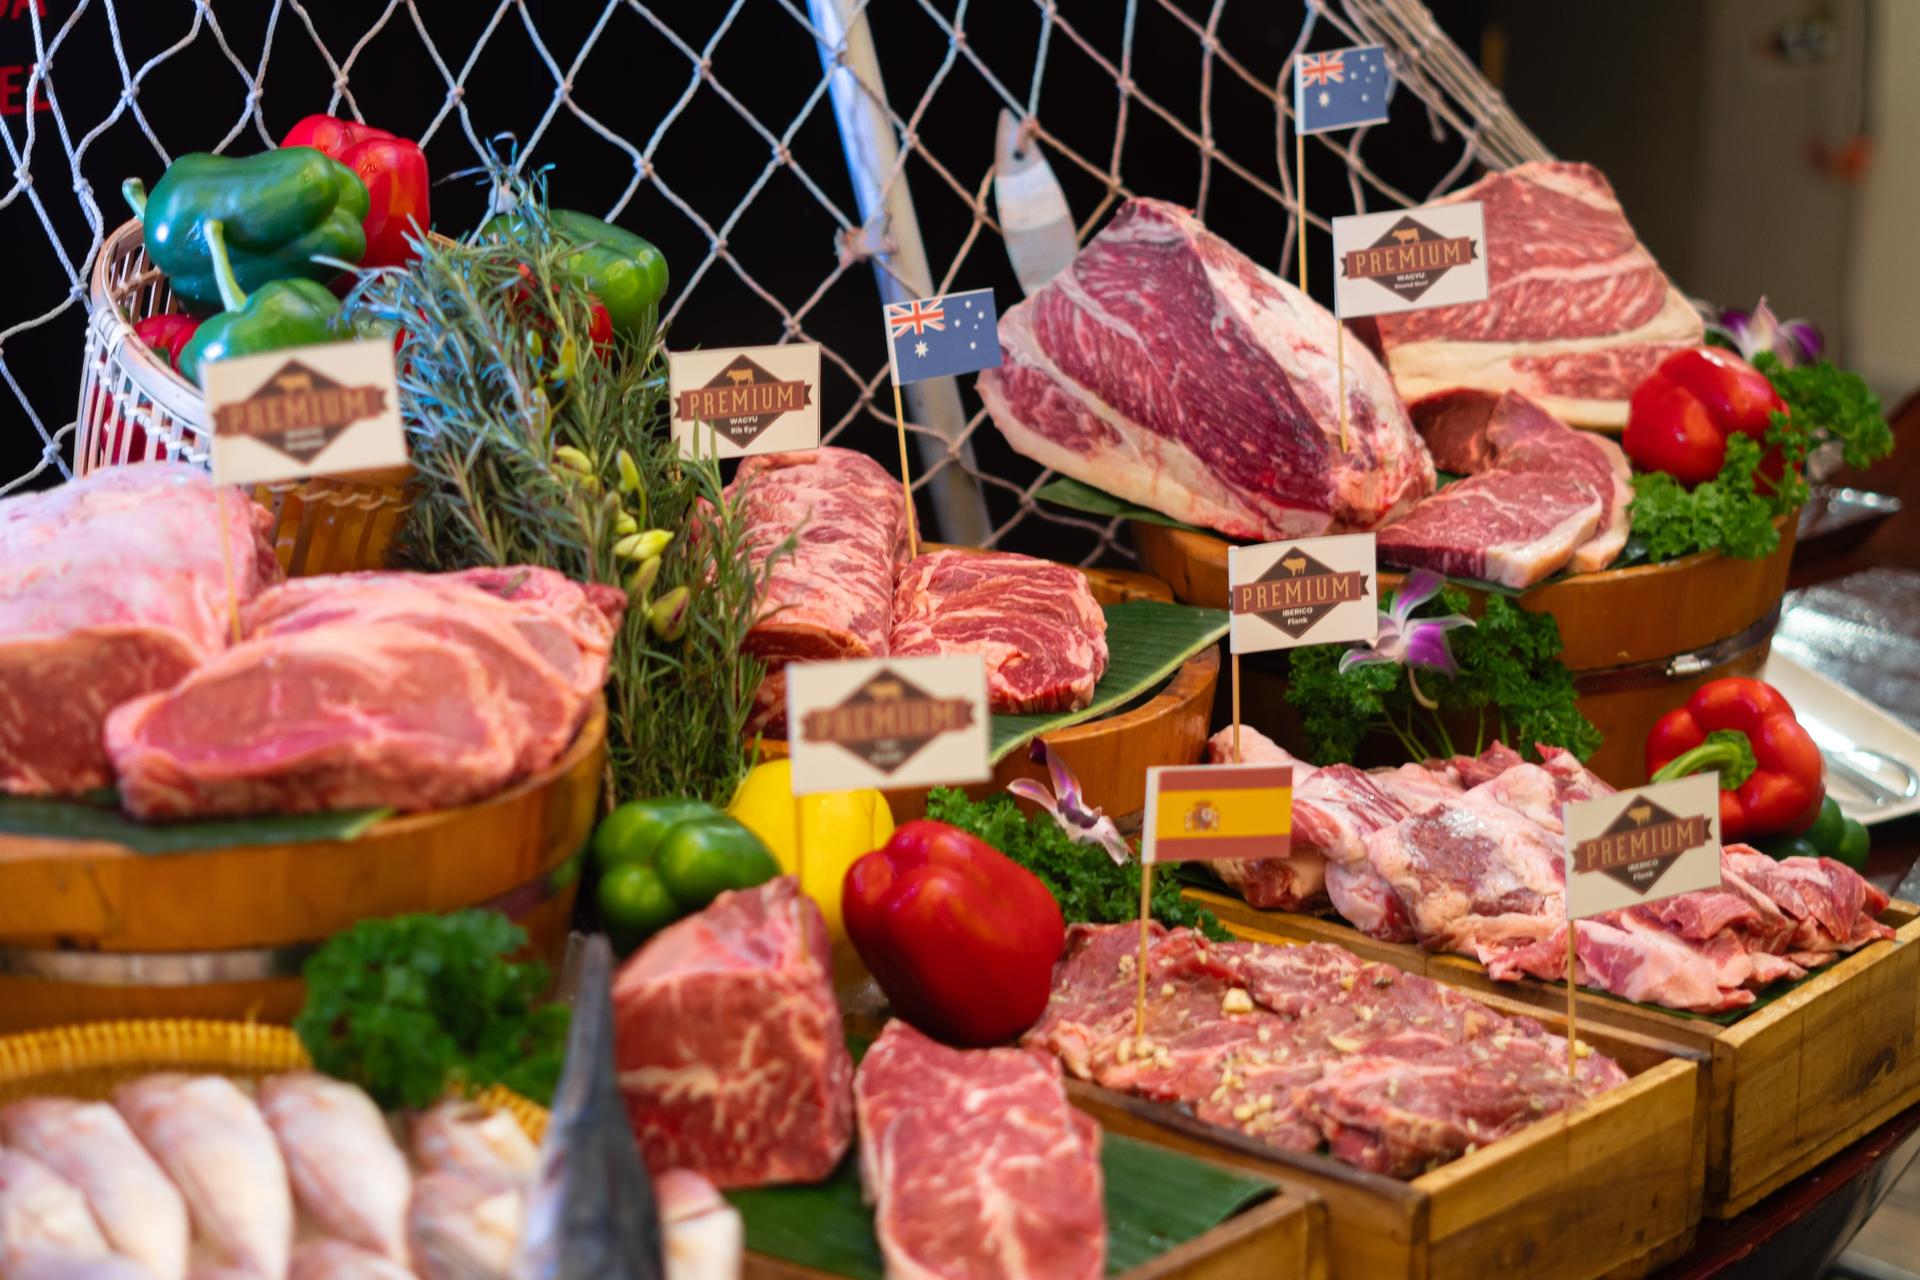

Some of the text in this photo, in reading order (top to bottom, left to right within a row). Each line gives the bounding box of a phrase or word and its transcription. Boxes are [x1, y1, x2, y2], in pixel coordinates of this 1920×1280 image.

[1355, 241, 1461, 275] PREMIUM
[1396, 271, 1426, 282] WAGYU
[689, 384, 794, 417] PREMIUM
[729, 415, 758, 425] WAGYU
[1242, 575, 1350, 611] PREMIUM
[1282, 606, 1313, 617] IBERICO
[1287, 616, 1308, 626] Flank
[1586, 820, 1694, 868] PREMIUM
[1627, 858, 1659, 872] IBERICO
[1633, 869, 1654, 882] Flank
